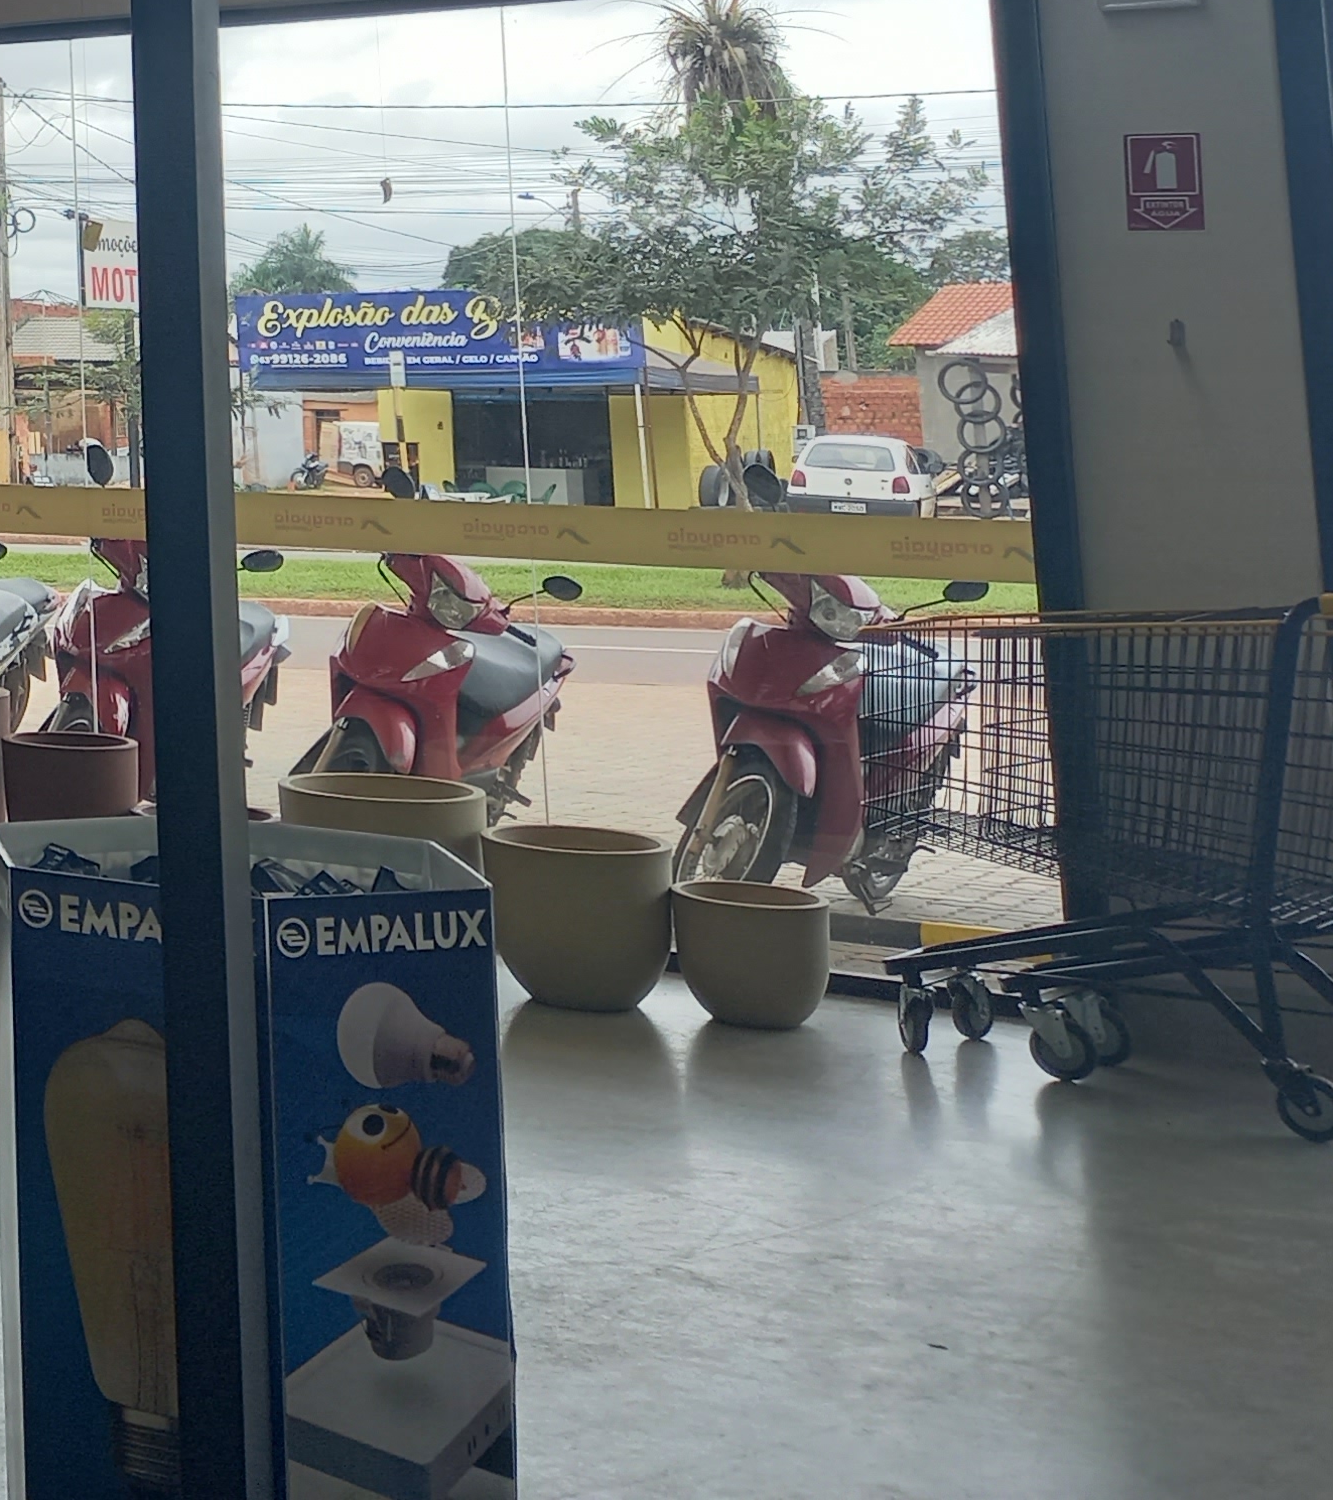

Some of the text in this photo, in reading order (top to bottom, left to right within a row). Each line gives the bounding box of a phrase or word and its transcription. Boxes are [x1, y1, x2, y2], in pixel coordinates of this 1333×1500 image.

[91, 266, 137, 303] MOT
[257, 298, 395, 338] Explosão
[400, 295, 459, 326] das
[364, 332, 469, 354] Conveniência
[59, 894, 162, 944] EMPA
[316, 909, 488, 956] EMPALUX
